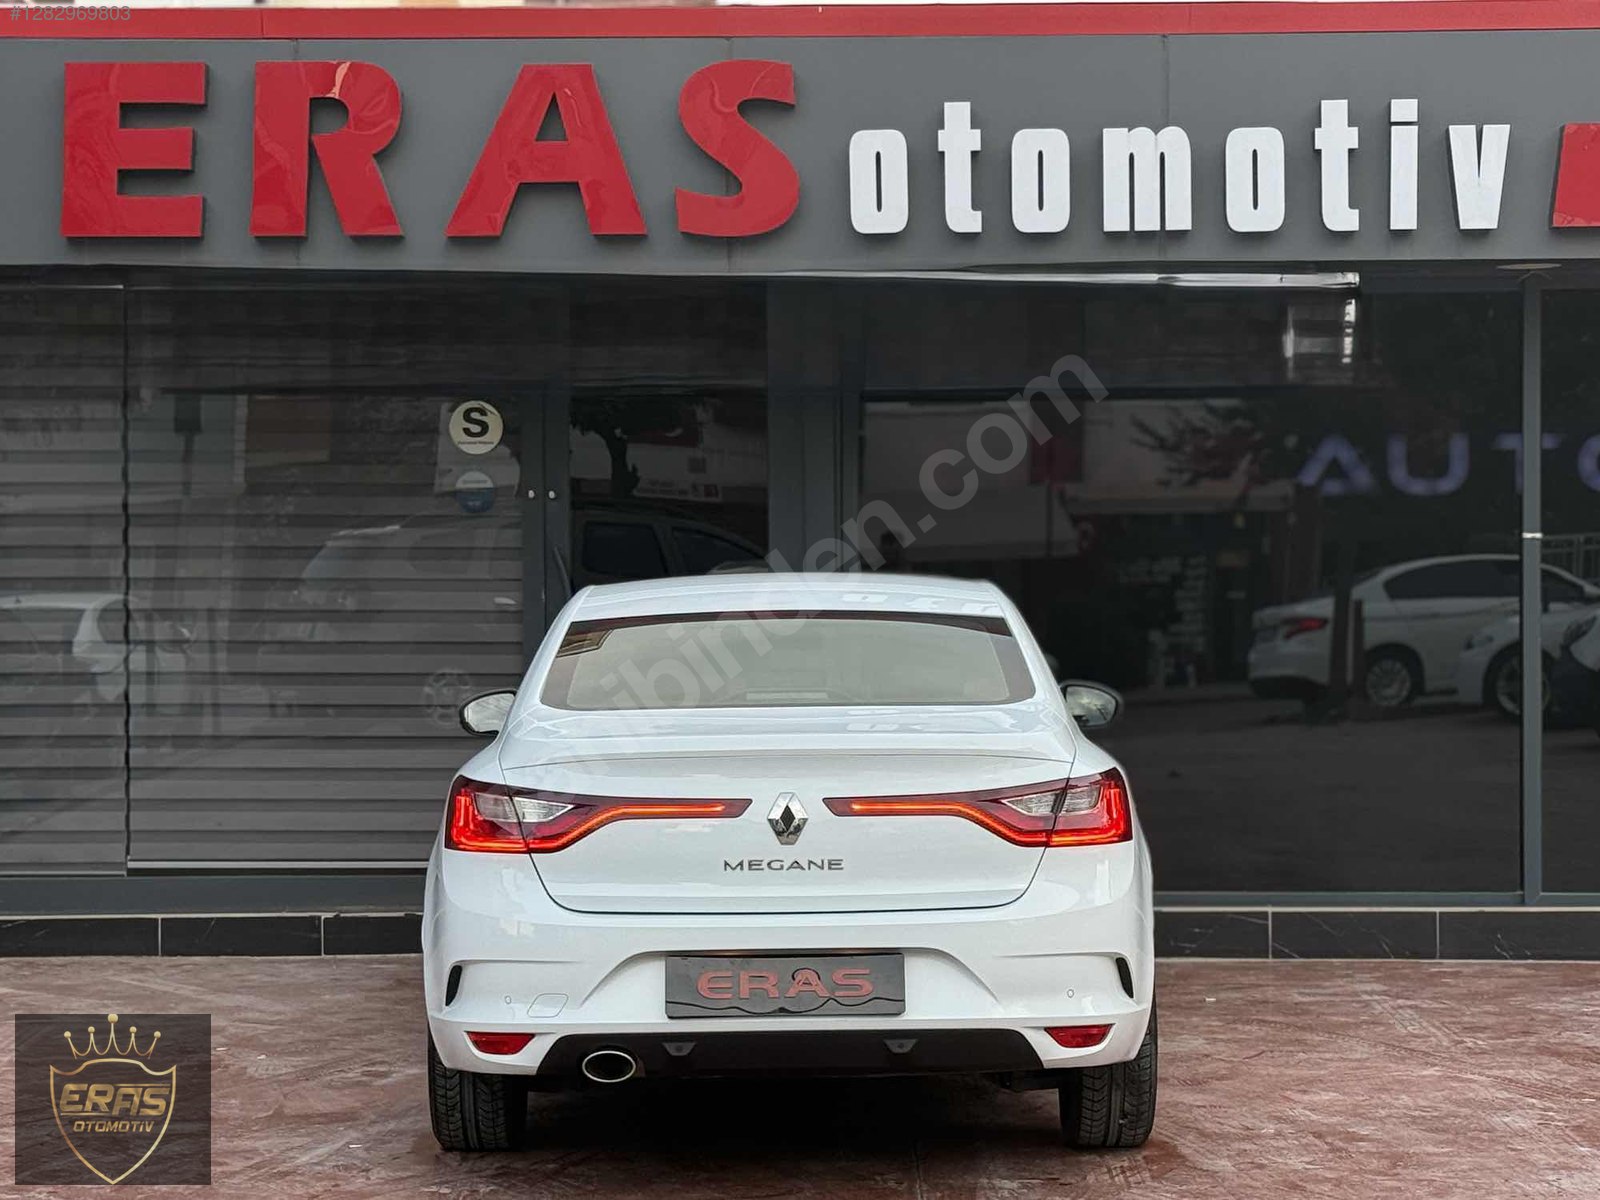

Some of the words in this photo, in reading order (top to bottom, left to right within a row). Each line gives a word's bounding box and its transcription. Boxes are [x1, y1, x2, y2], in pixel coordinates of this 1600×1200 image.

[61, 59, 801, 238] ERAS
[849, 98, 1511, 235] otomotiv
[462, 407, 490, 438] S
[1299, 433, 1600, 495] AUT
[723, 858, 845, 871] MEGANE
[696, 967, 875, 999] ERAS
